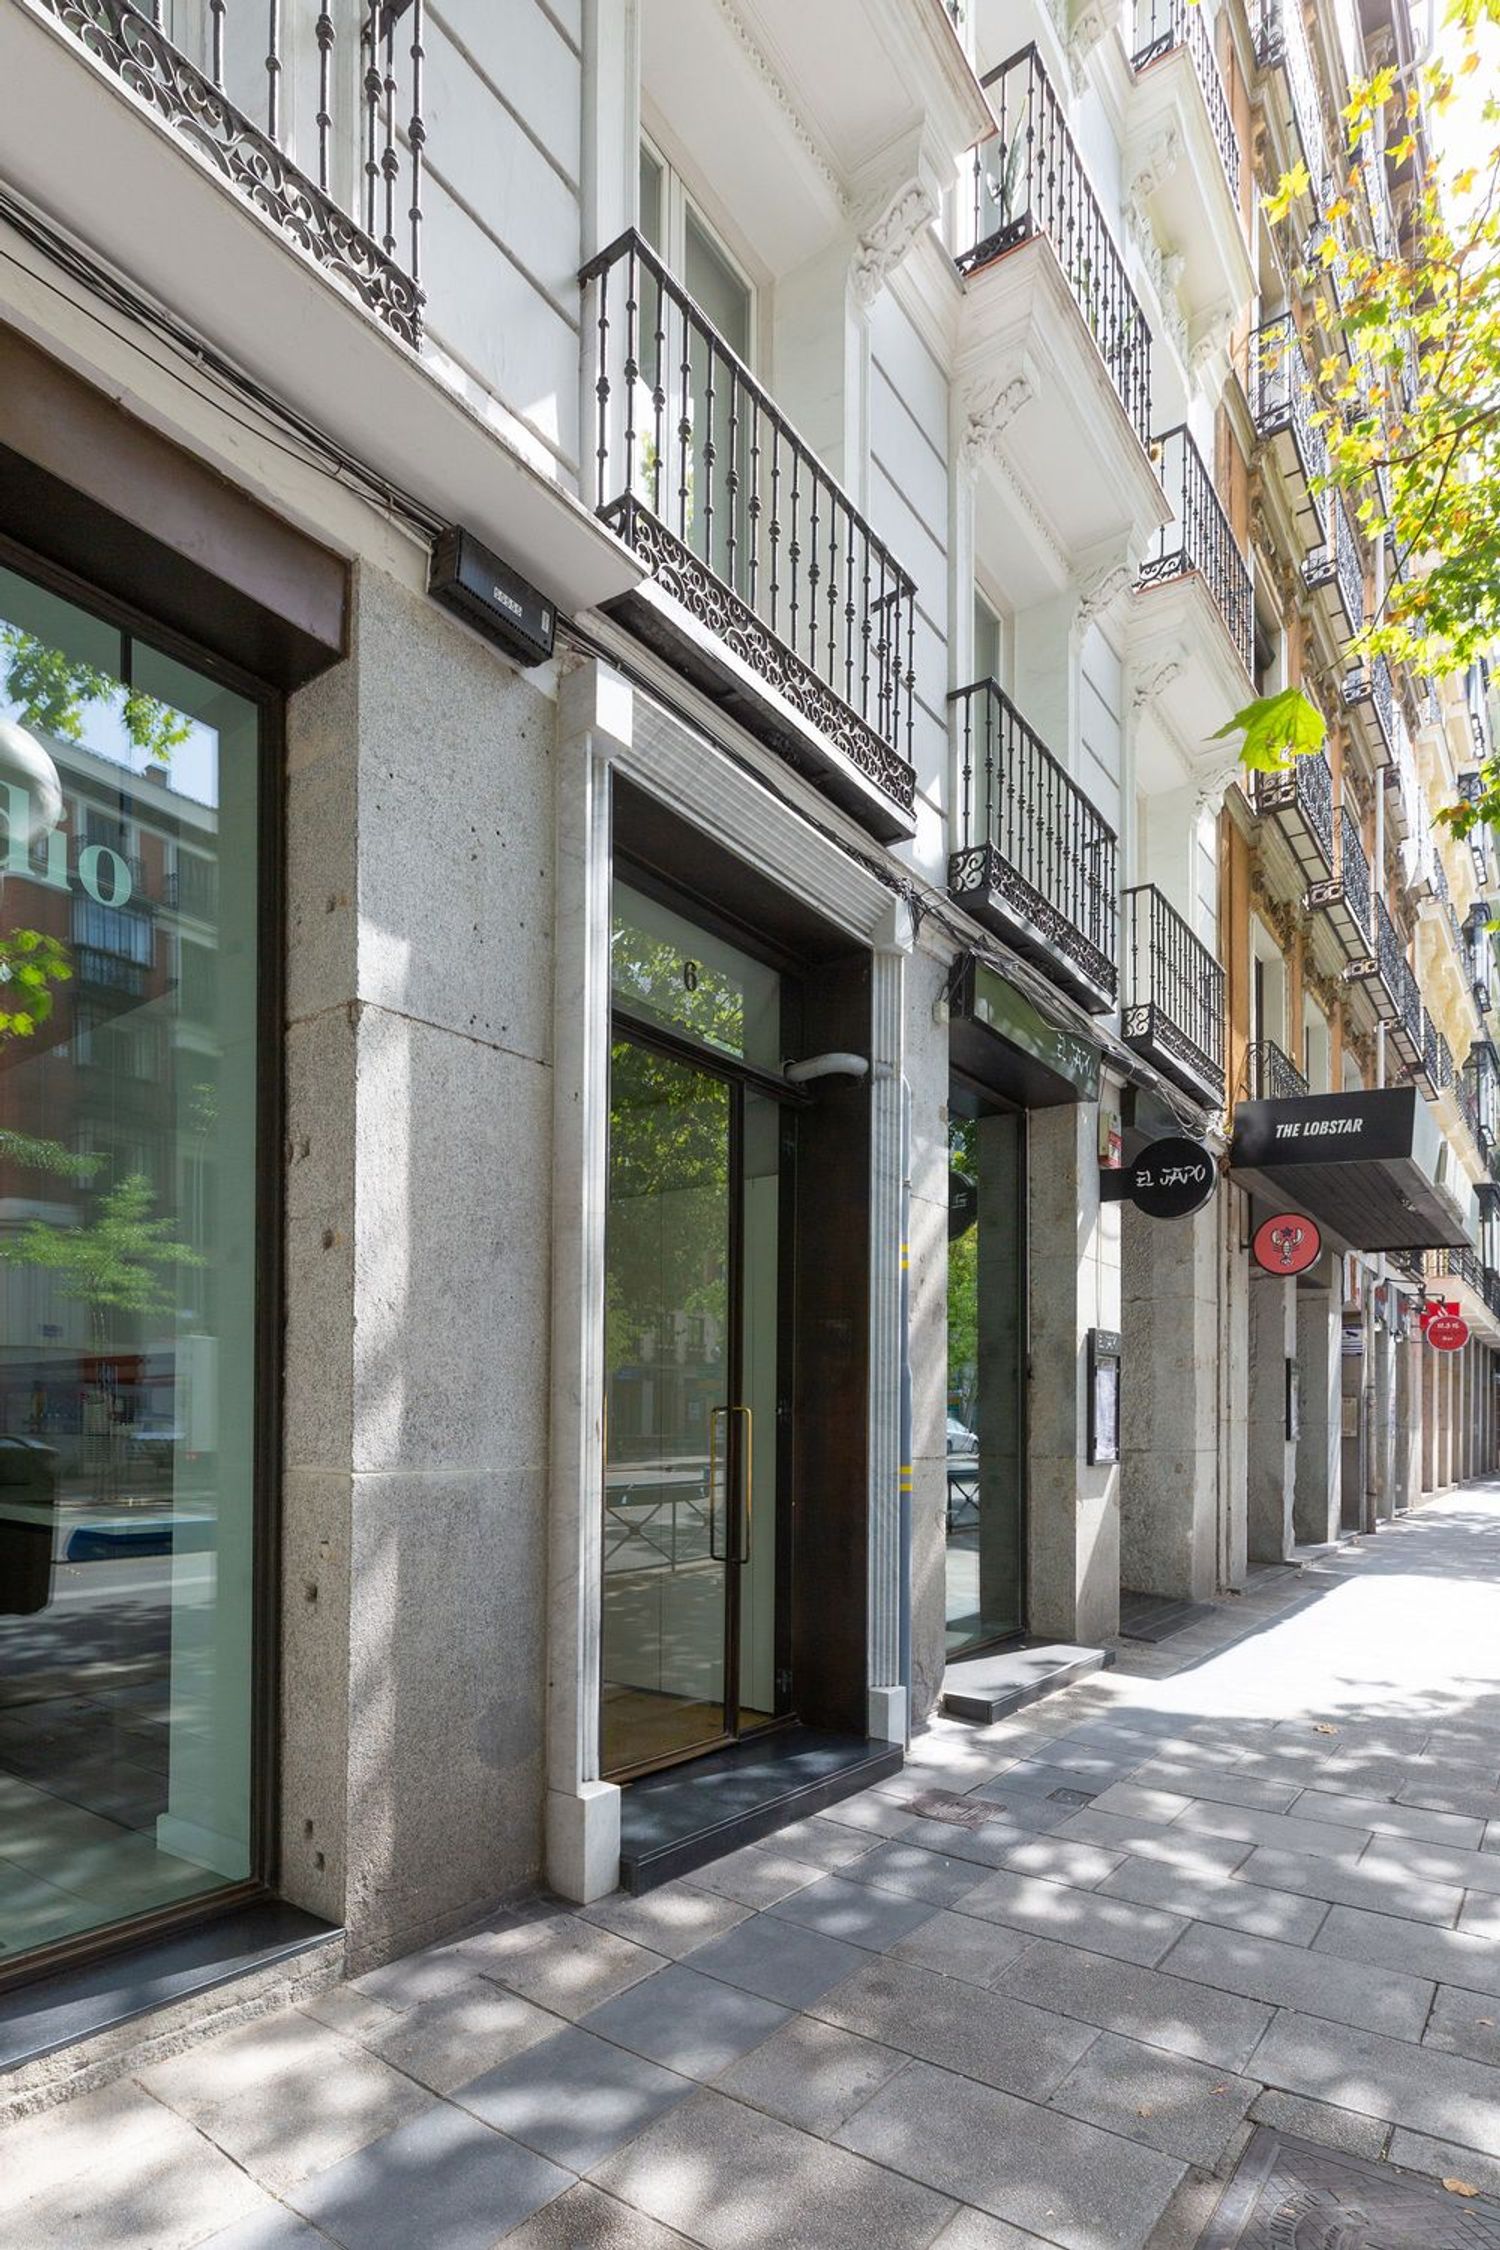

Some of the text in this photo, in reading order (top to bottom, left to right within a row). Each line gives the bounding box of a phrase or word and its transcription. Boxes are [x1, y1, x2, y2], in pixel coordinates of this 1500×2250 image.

[684, 961, 697, 992] 6
[1275, 1118, 1363, 1139] THE LOBSTAR
[1135, 1163, 1206, 1188] EL JAPO
